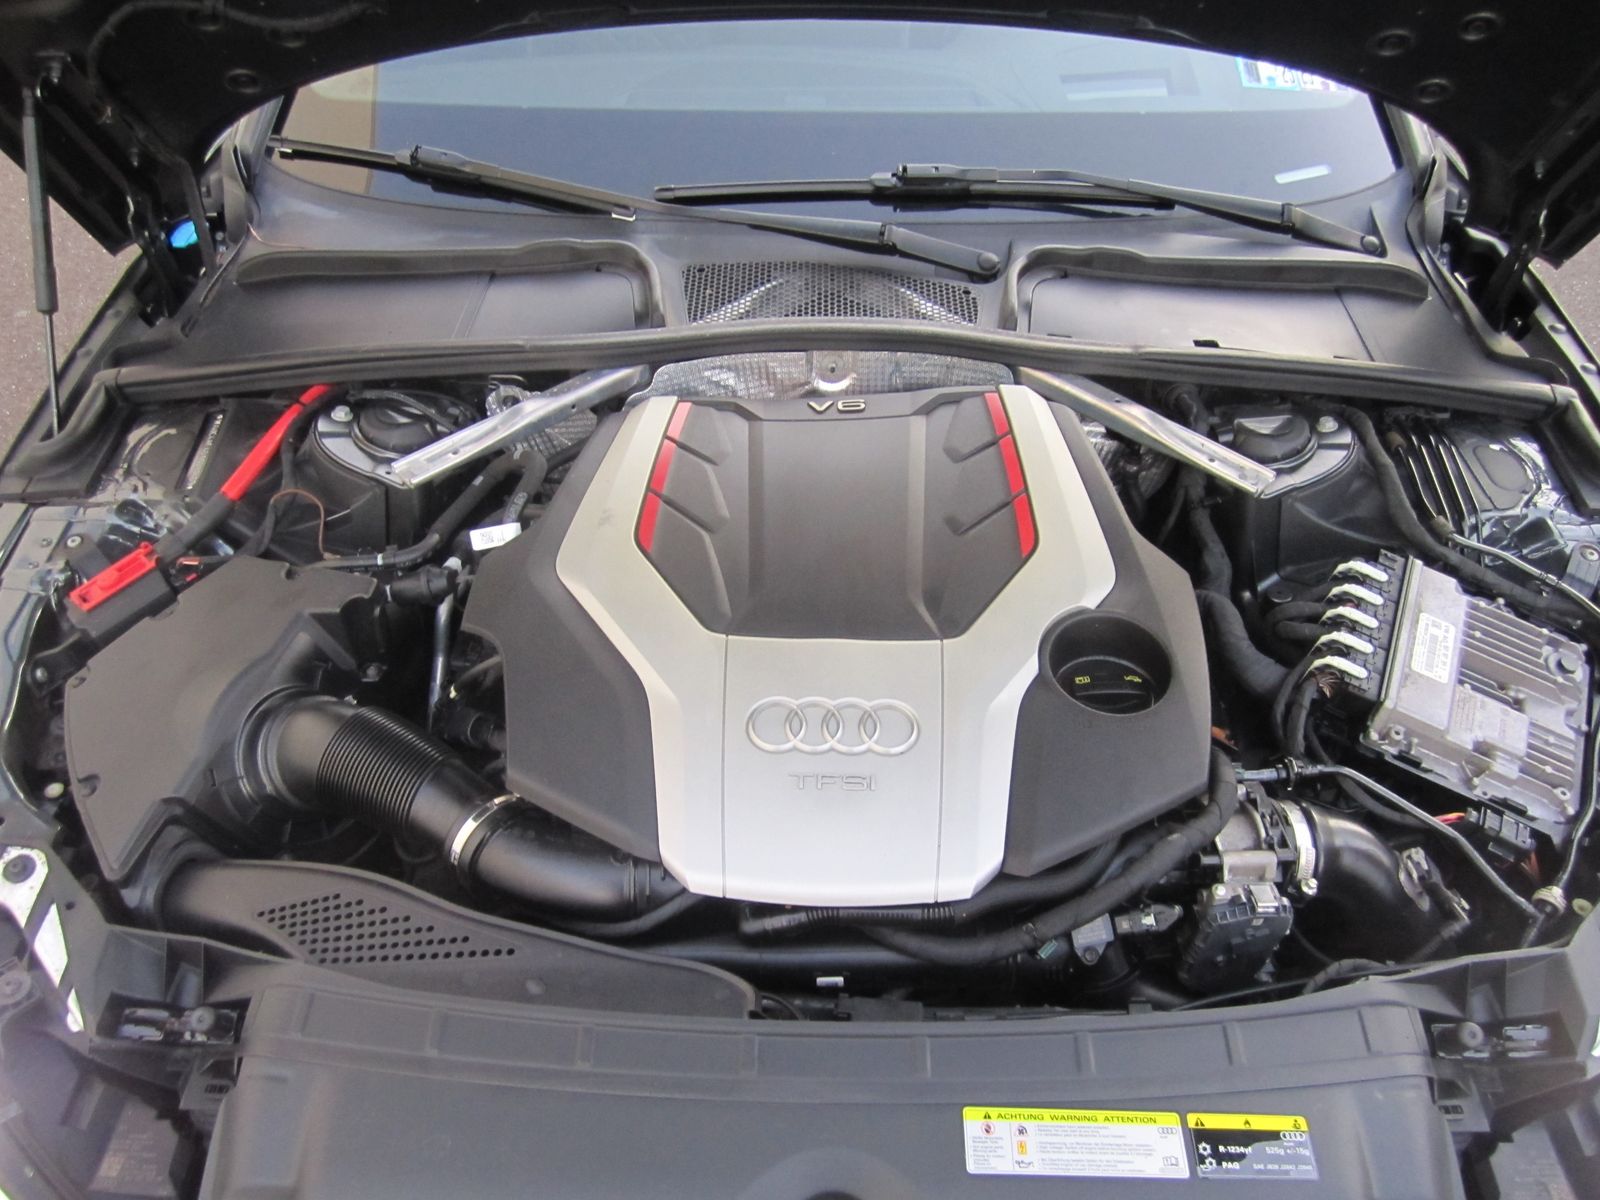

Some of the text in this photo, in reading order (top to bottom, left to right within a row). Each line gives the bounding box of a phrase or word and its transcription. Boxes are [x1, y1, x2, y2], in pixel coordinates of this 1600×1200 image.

[807, 399, 866, 415] V6
[788, 774, 877, 792] TFSI
[997, 1112, 1157, 1124] ACHTUNG WARNING ATTENTION
[1222, 1161, 1240, 1169] PAG
